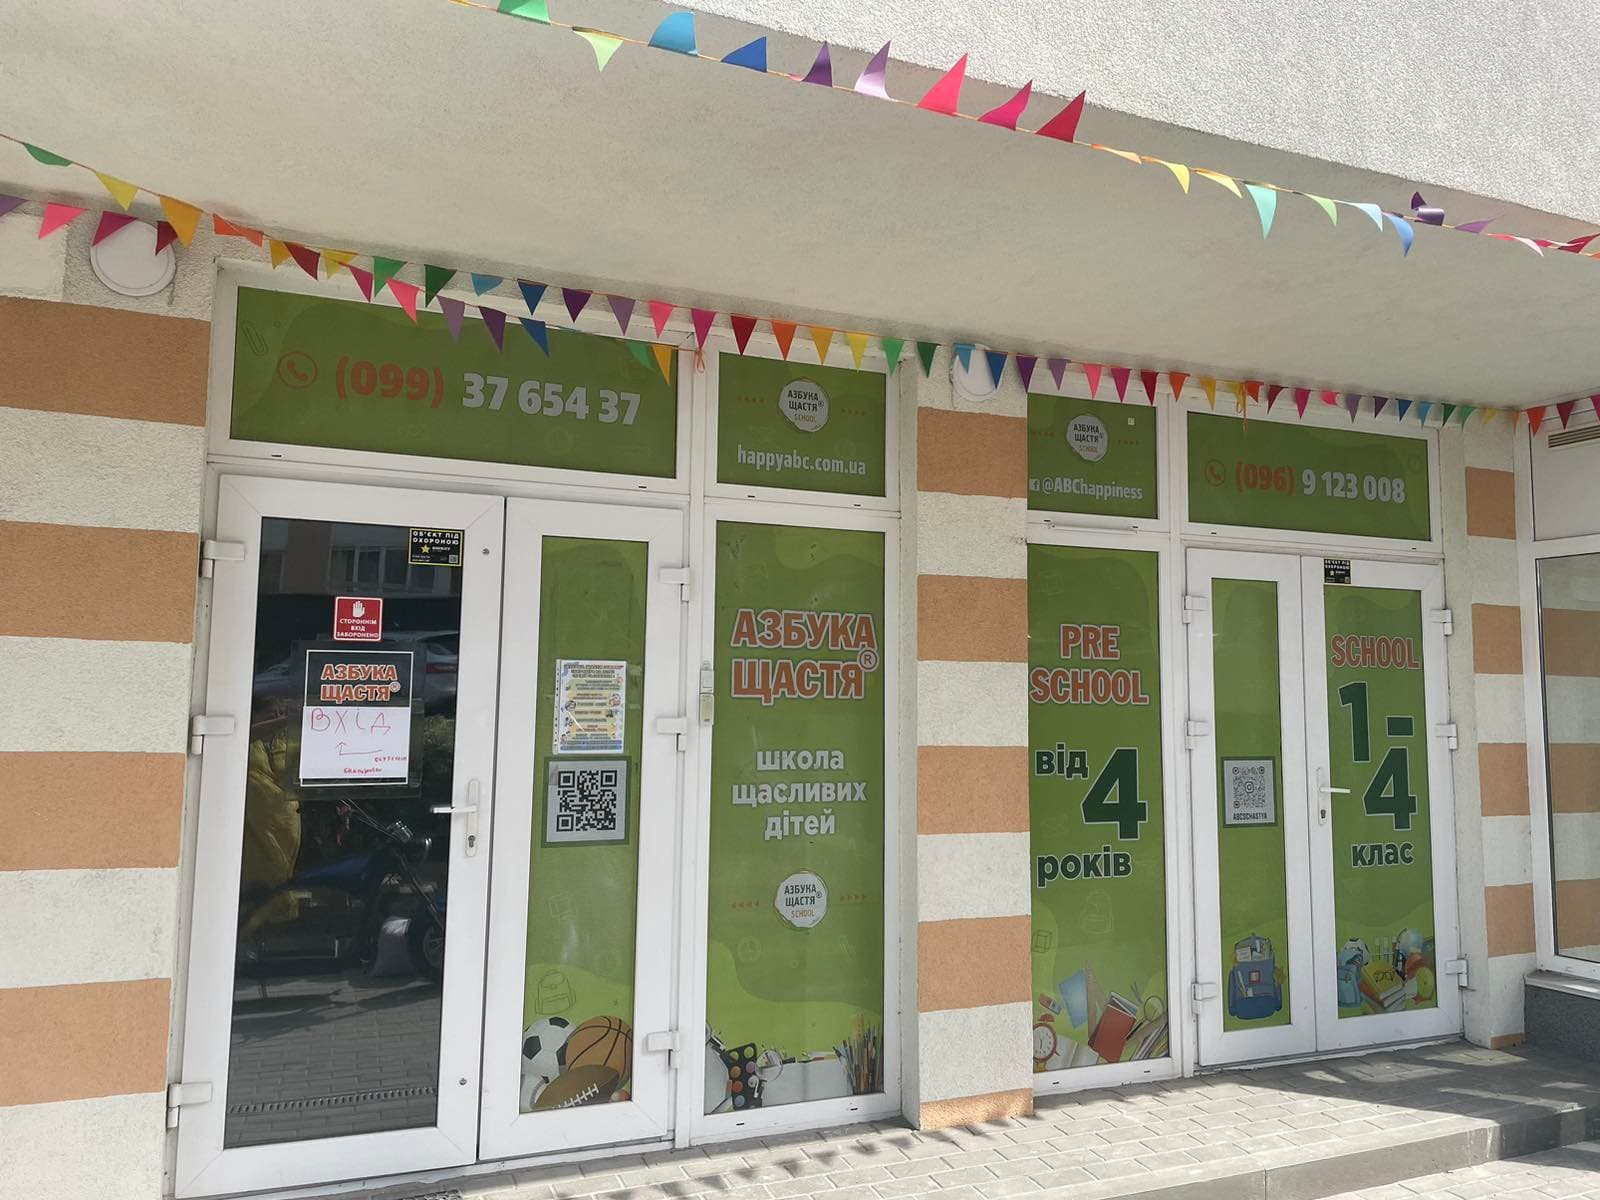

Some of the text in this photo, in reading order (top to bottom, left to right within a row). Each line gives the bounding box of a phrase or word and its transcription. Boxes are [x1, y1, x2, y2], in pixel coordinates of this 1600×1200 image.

[336, 355, 641, 426] (099) 37 654 37
[787, 390, 819, 401] АЗБУКА
[794, 413, 817, 423] SCHOOL
[1073, 423, 1100, 434] АЗБУКА
[737, 444, 867, 476] happyabc.com.ua
[1042, 477, 1144, 501] @ABChappiness
[1235, 461, 1406, 504] (096) 9 123 008
[730, 608, 877, 650] АЗБУКА
[1060, 624, 1121, 660] PRE
[1331, 634, 1421, 669] SCHOOL
[321, 664, 398, 681] АЗБУКА
[1029, 667, 1150, 704] SCHOOL
[756, 750, 845, 771] школа
[732, 782, 868, 808] щасливих
[1035, 742, 1148, 840] від 4
[764, 808, 836, 841] дітей
[1037, 845, 1133, 889] років
[1351, 842, 1415, 867] клас
[784, 884, 817, 895] АЗБУКА
[791, 910, 815, 918] SCHOOL
